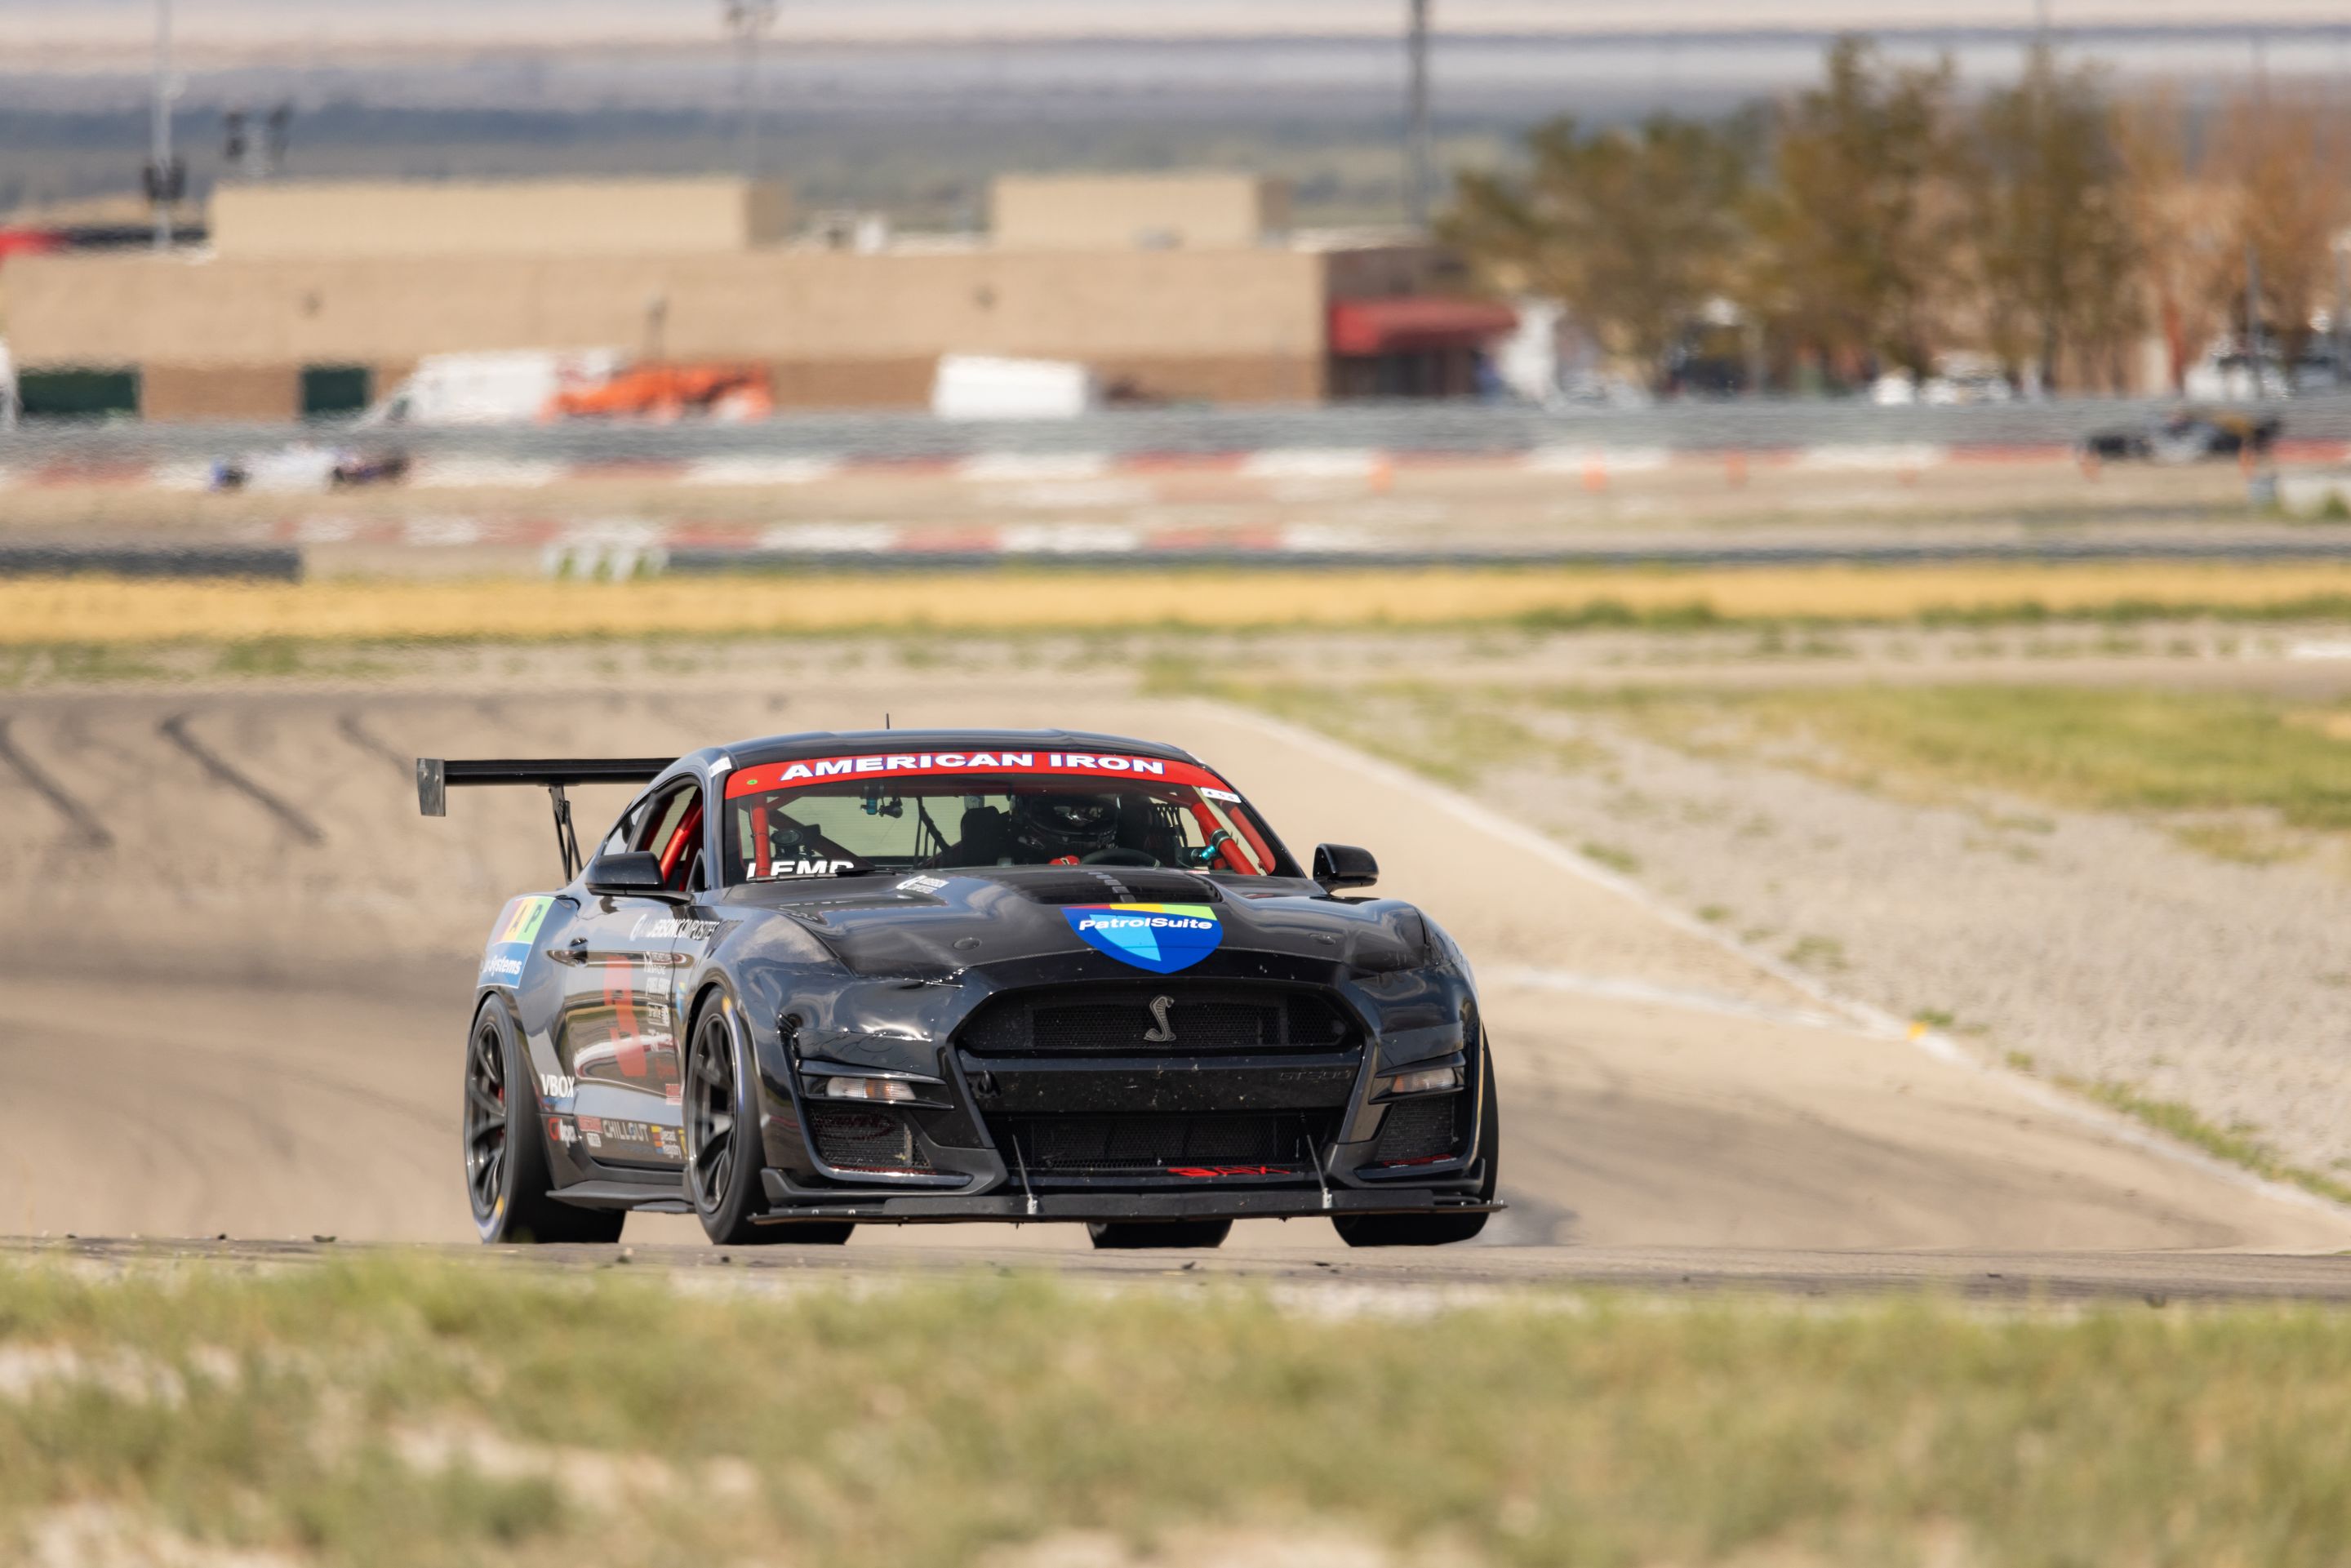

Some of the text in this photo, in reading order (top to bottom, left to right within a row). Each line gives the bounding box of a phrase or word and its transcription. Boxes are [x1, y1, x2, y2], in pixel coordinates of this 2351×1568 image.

[780, 753, 1164, 781] AMERICAN IRON
[1079, 917, 1213, 931] PatrolSuite
[540, 1073, 575, 1098] VBOX
[602, 1119, 649, 1142] CHILLOUT
